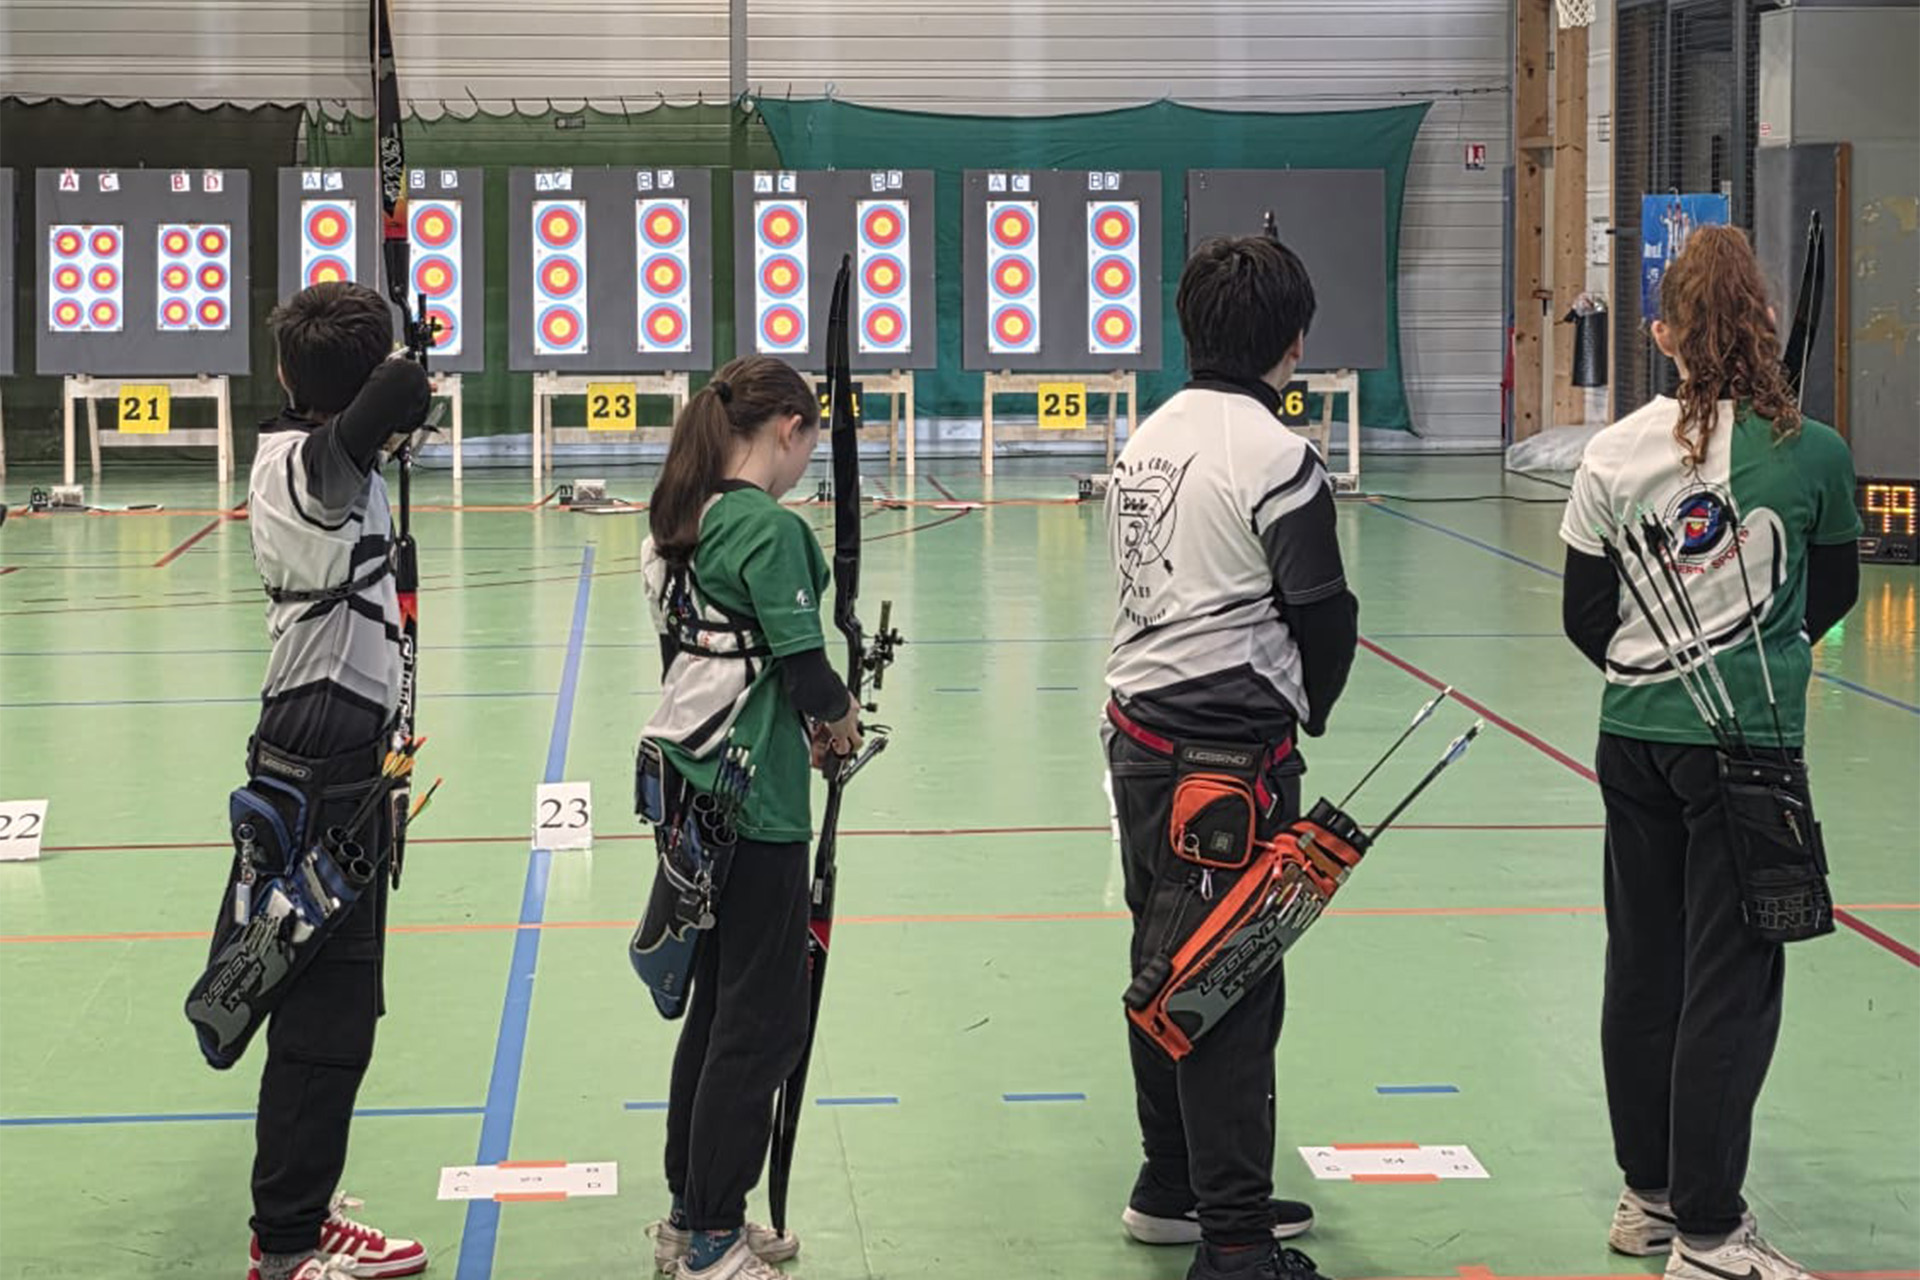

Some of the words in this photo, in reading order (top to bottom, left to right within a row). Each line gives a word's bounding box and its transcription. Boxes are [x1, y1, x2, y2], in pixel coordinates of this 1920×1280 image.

[63, 175, 76, 189] A
[101, 175, 114, 190] C
[173, 175, 185, 189] B
[206, 175, 218, 190] D
[305, 174, 317, 187] A
[325, 173, 337, 188] C
[412, 172, 424, 186] B
[443, 172, 456, 186] D
[538, 175, 550, 189] A
[555, 173, 567, 188] C
[639, 174, 651, 188] B
[659, 172, 672, 186] D
[757, 177, 768, 190] A
[779, 176, 791, 190] C
[873, 175, 886, 190] B
[888, 172, 901, 187] D
[991, 175, 1002, 189] A
[1013, 175, 1025, 190] C
[1091, 173, 1102, 188] B
[1106, 173, 1118, 188] D
[123, 397, 160, 421] 21
[593, 394, 631, 418] 23
[1044, 393, 1080, 417] 25
[1866, 485, 1916, 534] 99
[540, 797, 589, 828] 23
[1199, 912, 1279, 997] LEGEND
